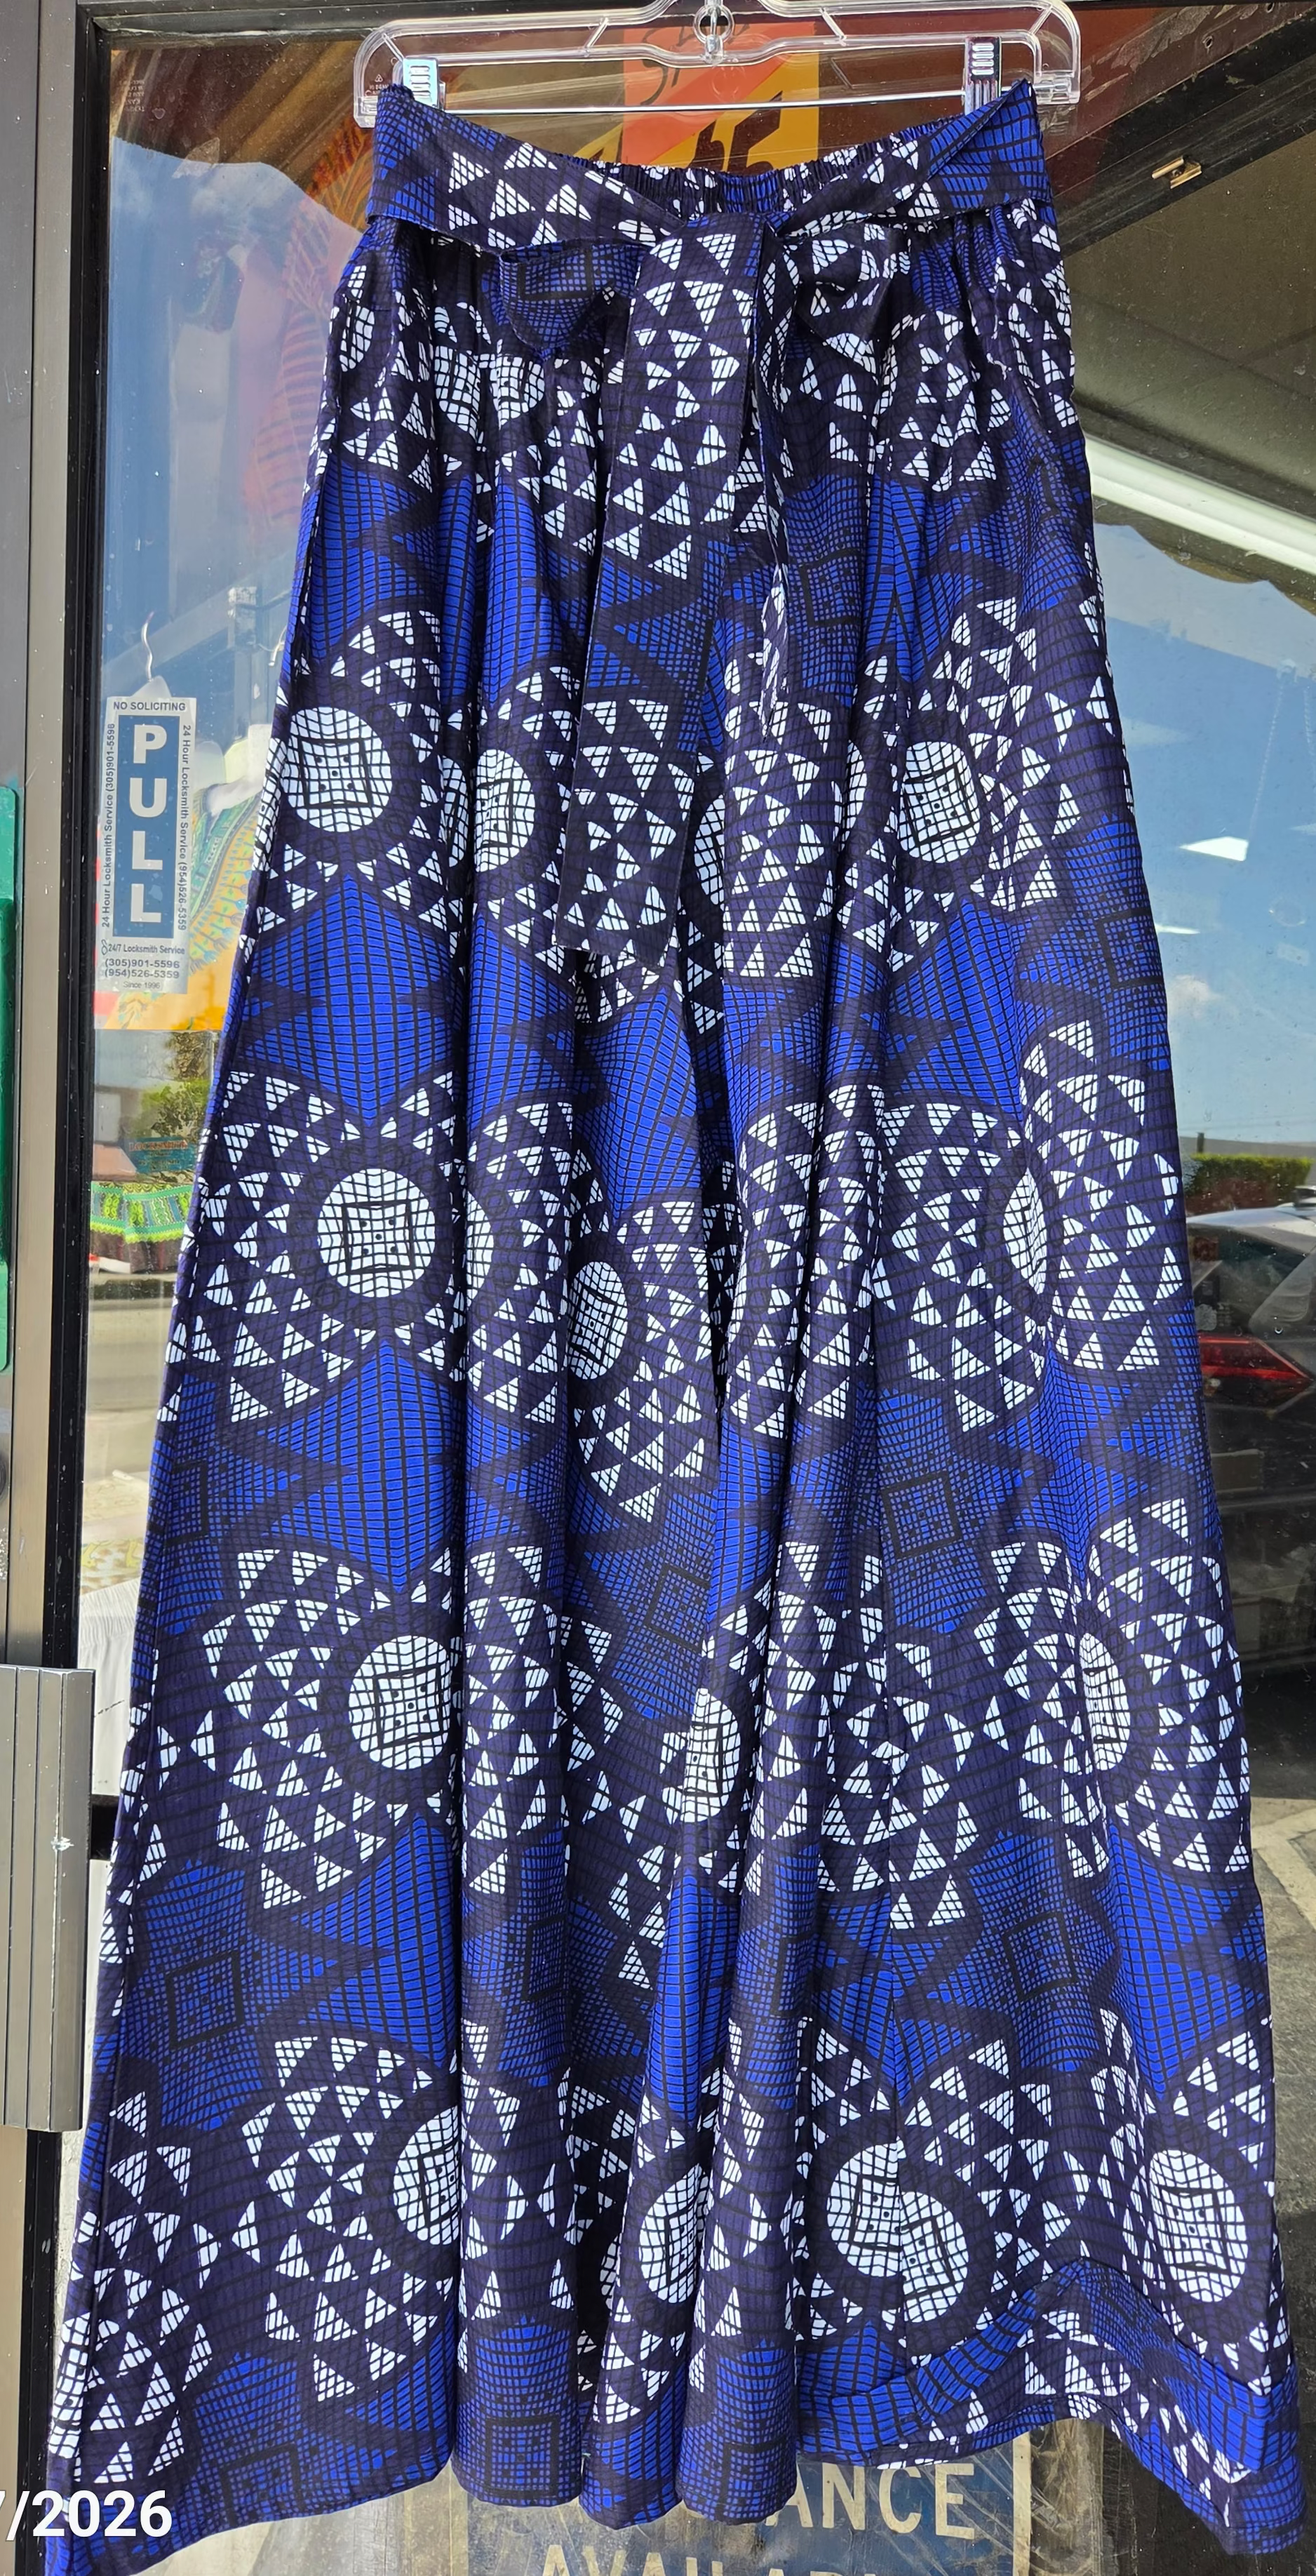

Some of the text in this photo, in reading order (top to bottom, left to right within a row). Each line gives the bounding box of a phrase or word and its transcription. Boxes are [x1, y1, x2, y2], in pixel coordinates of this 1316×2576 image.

[114, 702, 186, 712] NO SOLICITING
[104, 794, 113, 832] Service
[130, 724, 168, 923] PULL
[177, 725, 191, 931] 24 Hour Locksmith Service (954)526-5359
[102, 834, 112, 887] Locksmith
[102, 916, 110, 928] 24
[108, 944, 185, 955] 24/7 Locksmith Service
[105, 958, 180, 969] (305)901-5596
[105, 968, 180, 979] (954)526-5359
